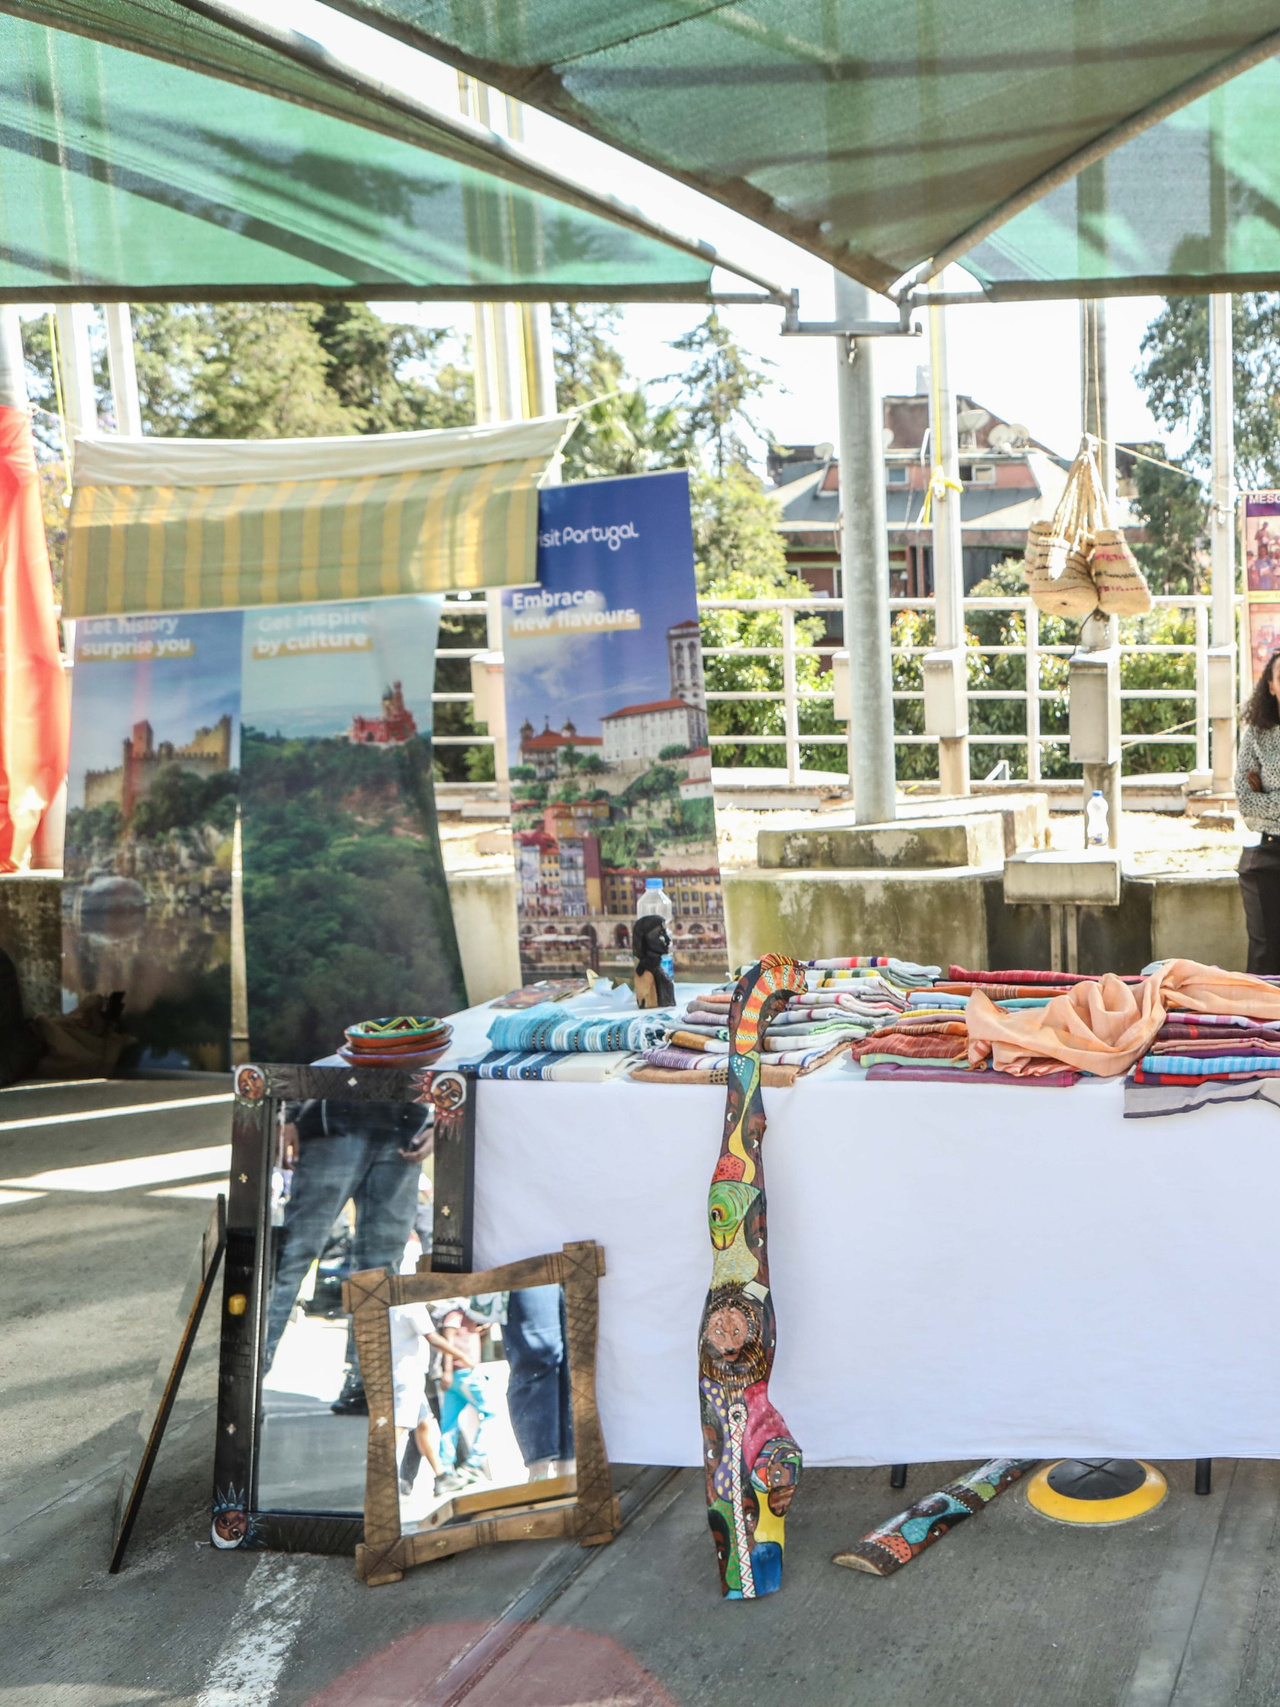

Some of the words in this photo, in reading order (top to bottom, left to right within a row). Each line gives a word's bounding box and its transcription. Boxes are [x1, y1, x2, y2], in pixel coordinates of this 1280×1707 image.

[538, 529, 561, 548] isit
[562, 521, 640, 551] Portugal
[512, 590, 597, 610] Embrace
[259, 615, 292, 632] Get
[513, 614, 551, 632] new
[557, 608, 636, 629] flavours
[80, 637, 154, 660] surprise
[155, 637, 191, 657] you
[257, 635, 281, 657] by
[285, 630, 368, 651] culture
